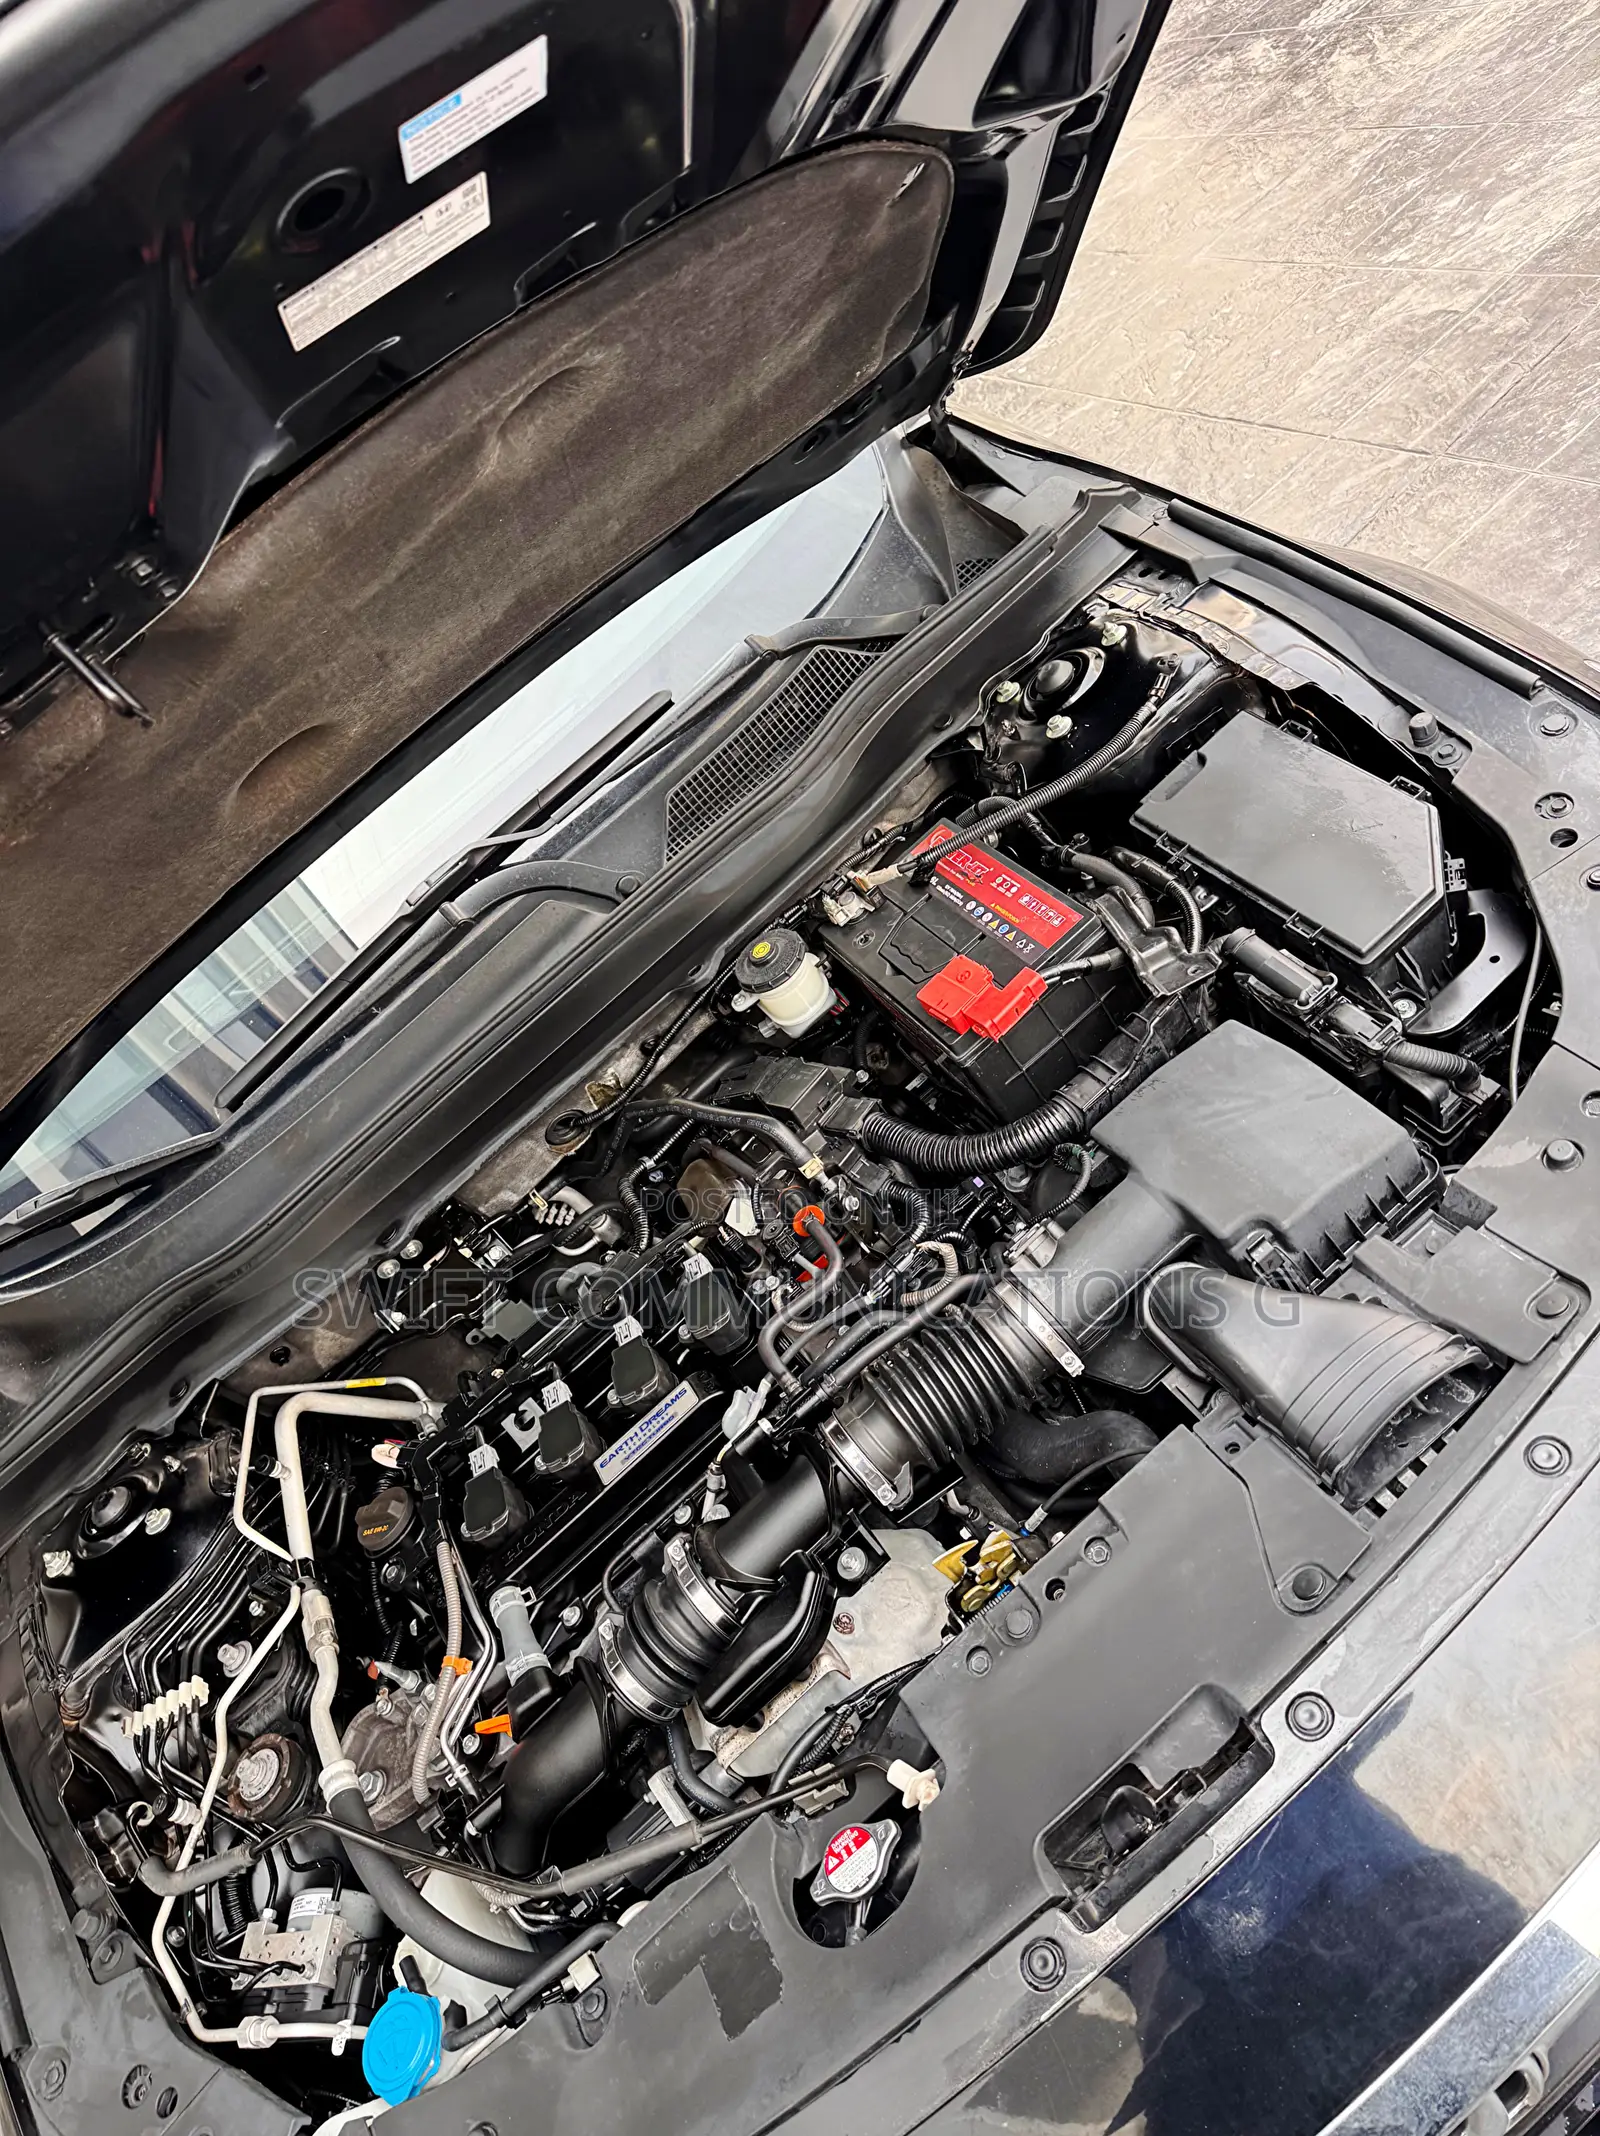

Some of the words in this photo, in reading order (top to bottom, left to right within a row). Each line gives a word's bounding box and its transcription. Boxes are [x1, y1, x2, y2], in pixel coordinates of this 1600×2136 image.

[599, 1431, 639, 1469] EARTH
[638, 1387, 687, 1433] DREAMS
[623, 1412, 670, 1455] TECHNOLOGY
[362, 1527, 374, 1537] SAE
[502, 1491, 588, 1568] HONDA
[831, 1829, 852, 1850] DANGER
